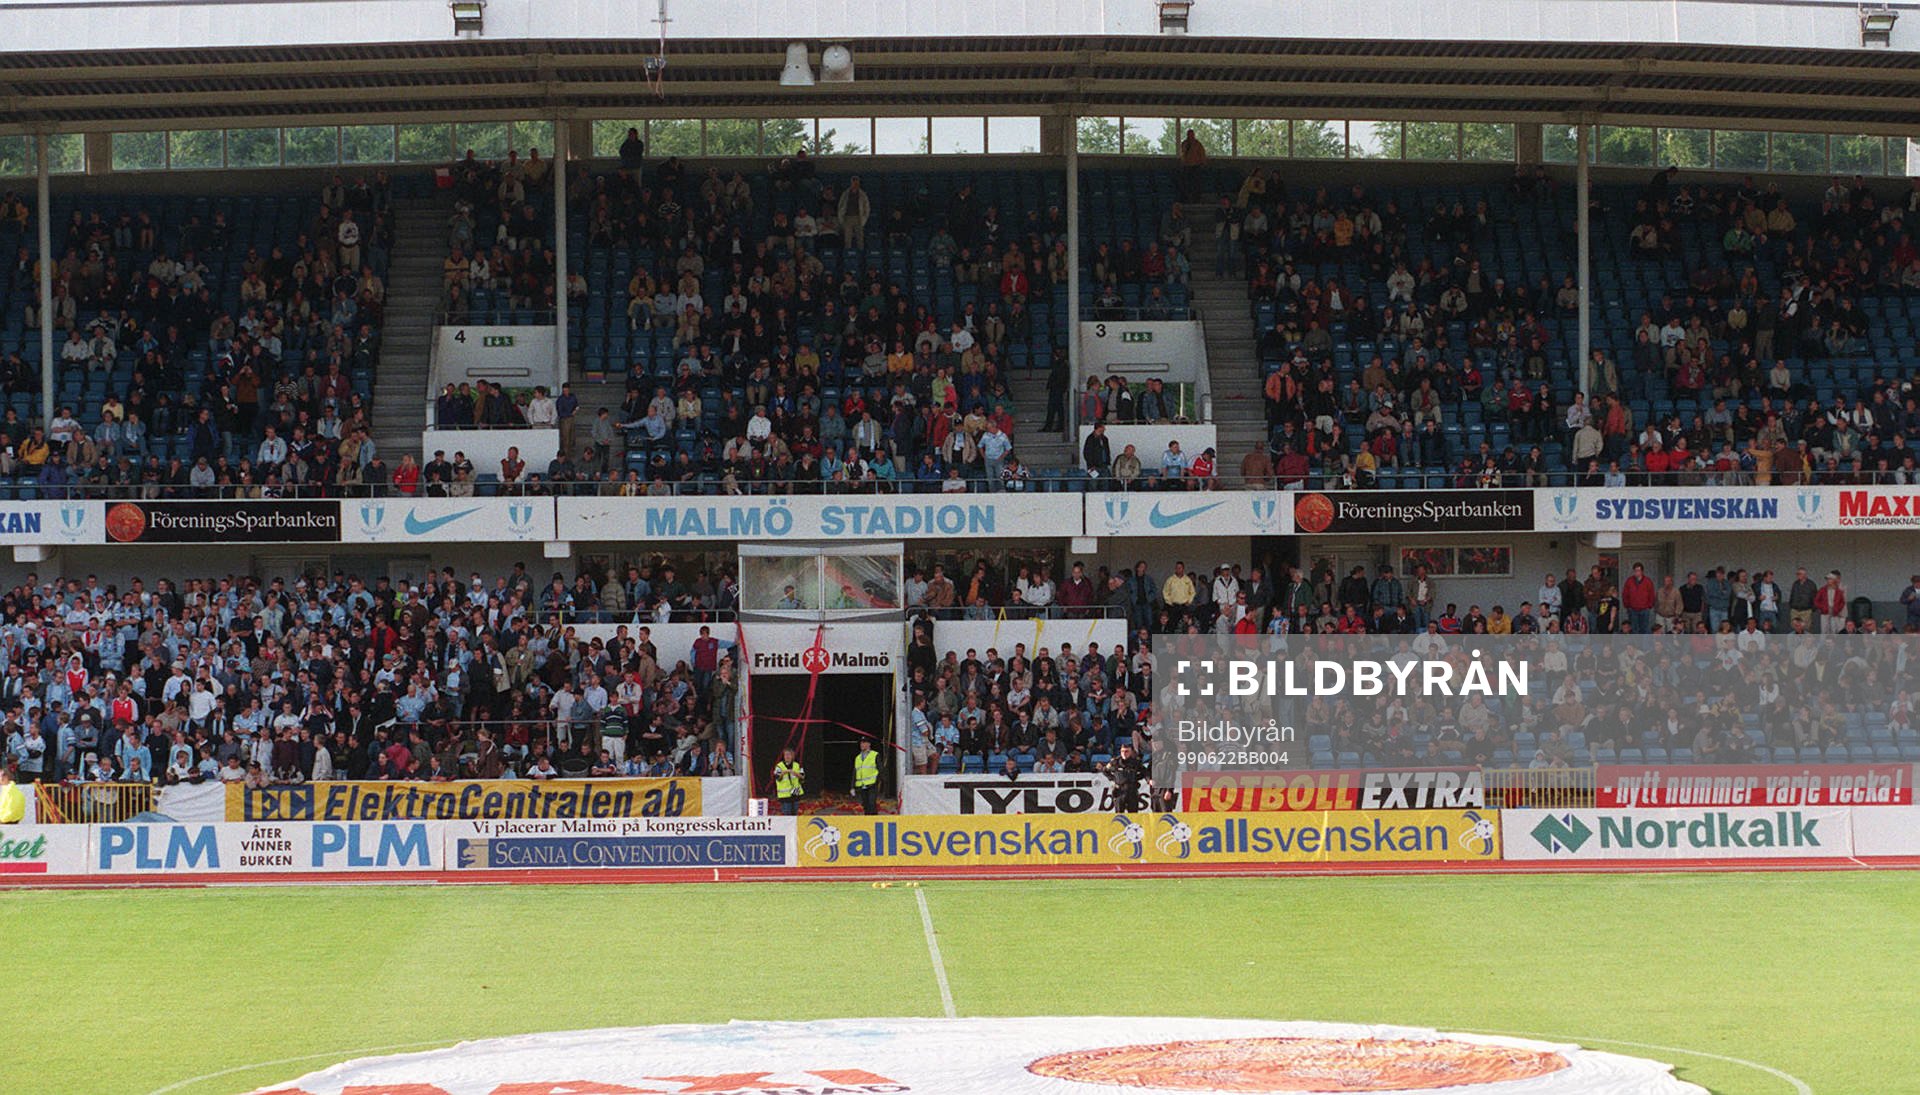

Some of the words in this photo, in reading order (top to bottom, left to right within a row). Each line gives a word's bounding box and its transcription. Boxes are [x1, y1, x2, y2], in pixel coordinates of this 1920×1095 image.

[455, 330, 466, 343] 4
[1096, 324, 1106, 337] 3
[150, 510, 336, 531] FöreningsSparbanken
[645, 499, 793, 536] MALMÖ
[820, 505, 995, 534] STADION
[1338, 500, 1522, 521] FöreningsSparbanken
[1596, 498, 1778, 519] SYDSVENSKAN
[755, 653, 799, 667] Fritid
[832, 652, 889, 667] Malmö
[324, 783, 632, 820] ElektroCentralen
[642, 780, 686, 817] ab
[944, 781, 1094, 814] TYLÖ
[1188, 774, 1356, 812] FOTBOLL
[1361, 771, 1485, 809] EXTRA
[1616, 771, 1660, 808] nytt
[1665, 776, 1758, 804] nummer
[1766, 770, 1822, 805] varje
[1829, 769, 1903, 803] vecka!
[252, 825, 281, 838] ÅTER
[473, 821, 488, 834] Vi
[495, 820, 556, 837] placerar
[561, 819, 616, 833] Malmö
[622, 819, 641, 836] på
[646, 818, 772, 836] kongresskartan!
[847, 822, 1099, 857] allsvenskan
[1198, 818, 1449, 853] allsvenskan
[1597, 811, 1821, 849] Nordkalk
[0, 832, 47, 858] set
[100, 825, 220, 869] PLM
[241, 841, 291, 851] VINNER
[311, 823, 431, 867] PLM
[495, 842, 567, 865] SCANIA
[573, 842, 699, 864] CONVENTION
[707, 840, 782, 863] CENTRE
[240, 855, 292, 866] BURKEN
